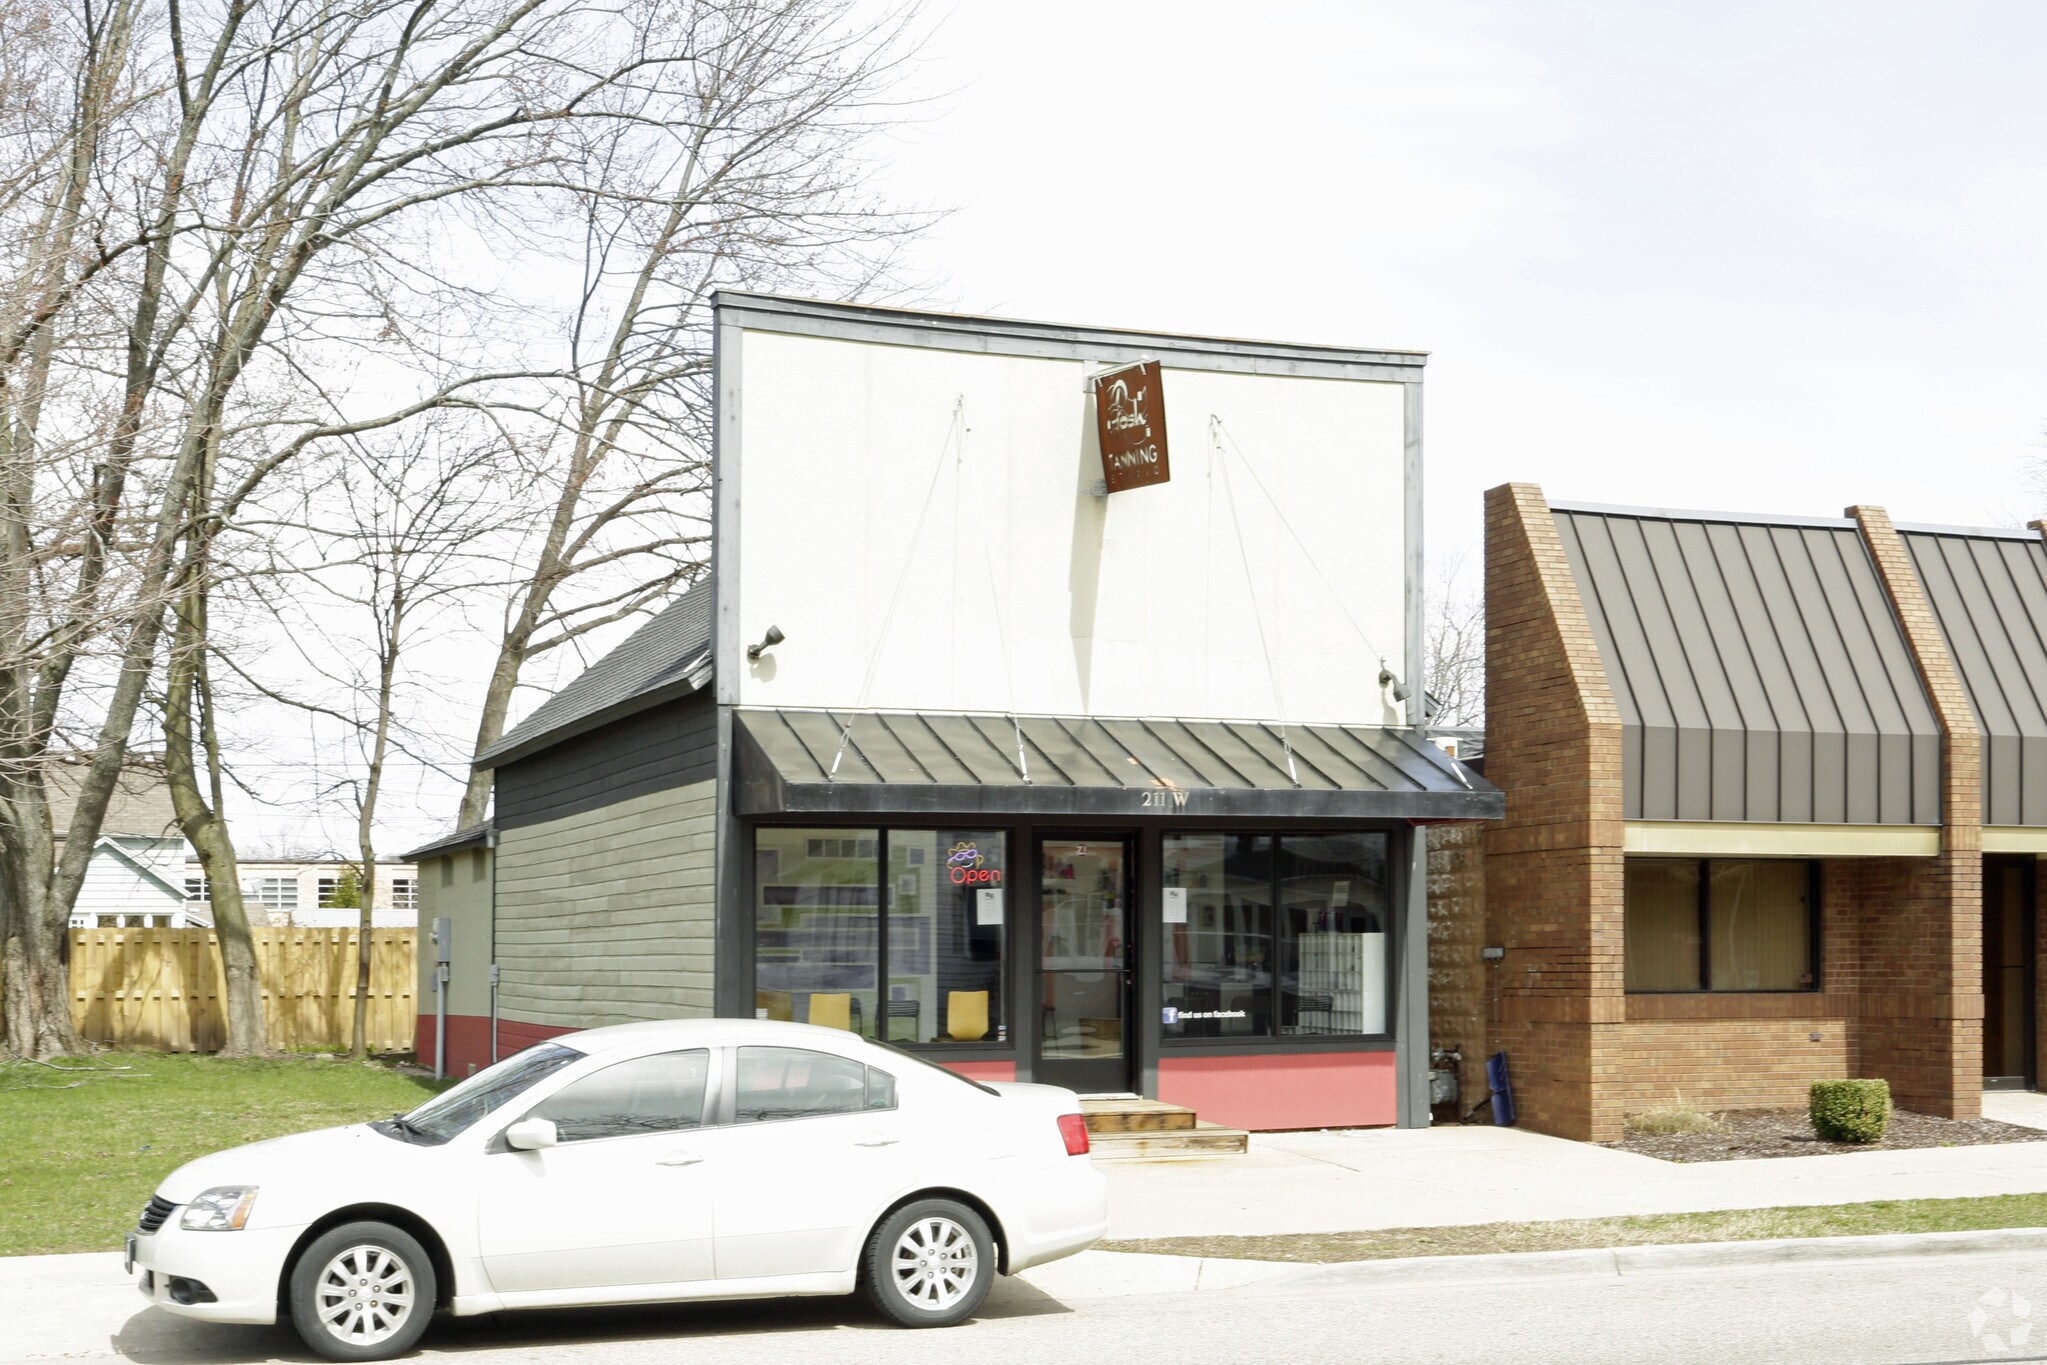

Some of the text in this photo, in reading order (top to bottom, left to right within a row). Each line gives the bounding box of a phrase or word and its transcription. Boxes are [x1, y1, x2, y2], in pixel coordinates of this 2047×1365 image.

[1141, 791, 1190, 807] 211 W
[950, 866, 1002, 885] Open
[1177, 1011, 1193, 1019] find
[1213, 1010, 1246, 1018] facebook
